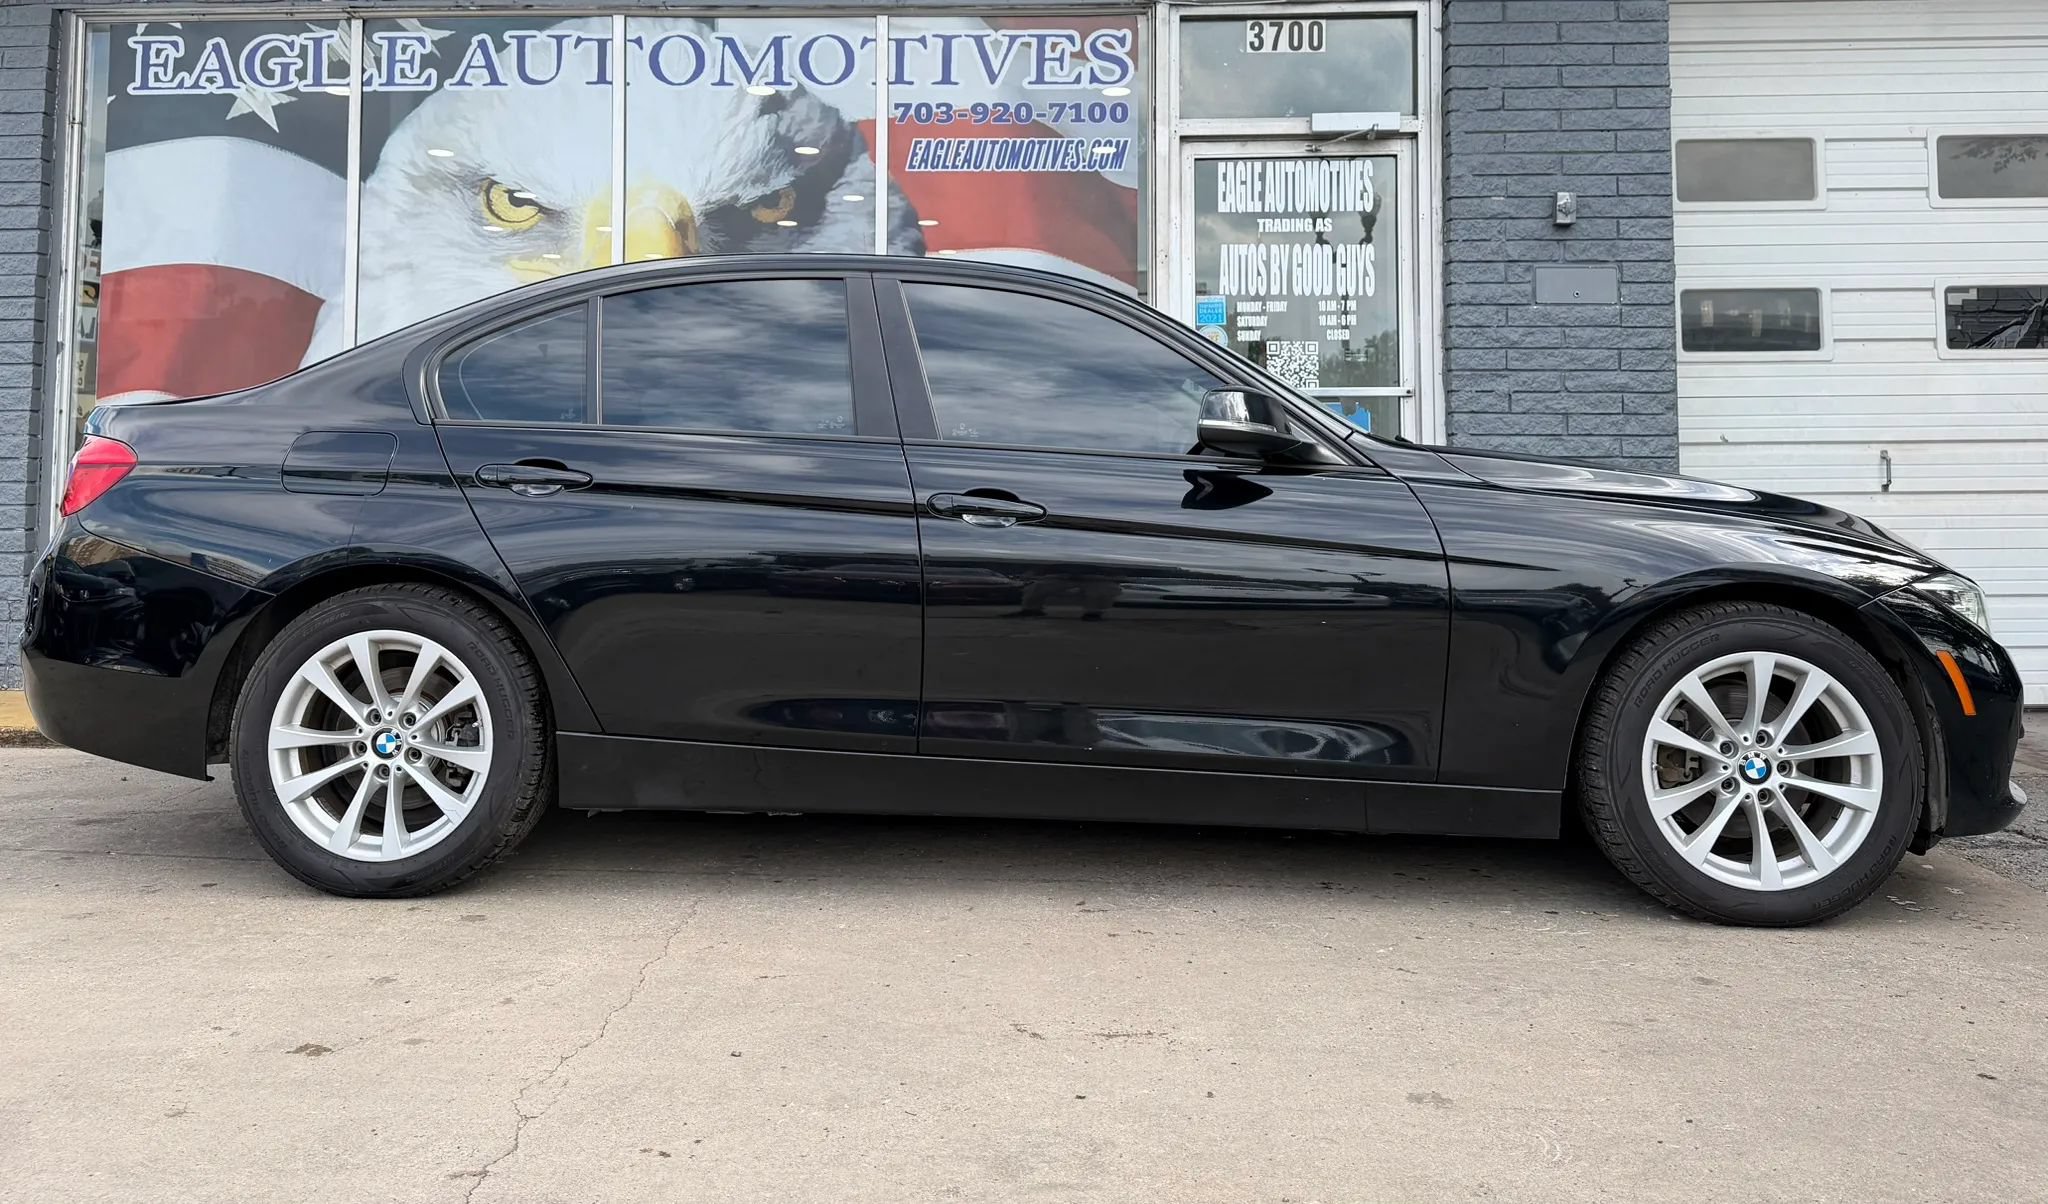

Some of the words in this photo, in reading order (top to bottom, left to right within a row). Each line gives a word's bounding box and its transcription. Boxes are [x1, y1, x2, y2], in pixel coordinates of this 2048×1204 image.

[1249, 20, 1324, 51] 3700
[128, 30, 437, 95] EAGLE
[444, 28, 1137, 92] AUTOMOTIVES
[894, 101, 1130, 125] 703-920-7100
[906, 137, 1131, 173] EAGLEAUTOMOTIVES.COM
[1217, 160, 1262, 213] EAGLE
[1264, 159, 1374, 213] AUTOMOTIVES
[1257, 218, 1313, 233] TRADING
[1315, 218, 1333, 233] AS
[1219, 243, 1267, 297] AUTOS
[1270, 243, 1290, 296] BY
[1292, 243, 1333, 296] GOOD
[1336, 243, 1375, 297] GUYS
[1236, 301, 1262, 313] MONDAY
[1266, 301, 1288, 313] FRIDAY
[1326, 300, 1338, 311] AM
[1346, 300, 1357, 311] PM
[1236, 315, 1268, 328] SATURDAY
[1326, 315, 1338, 326] AM
[1346, 315, 1357, 326] PM
[1236, 329, 1261, 342] SUNDAY
[1326, 328, 1350, 340] CLOSED
